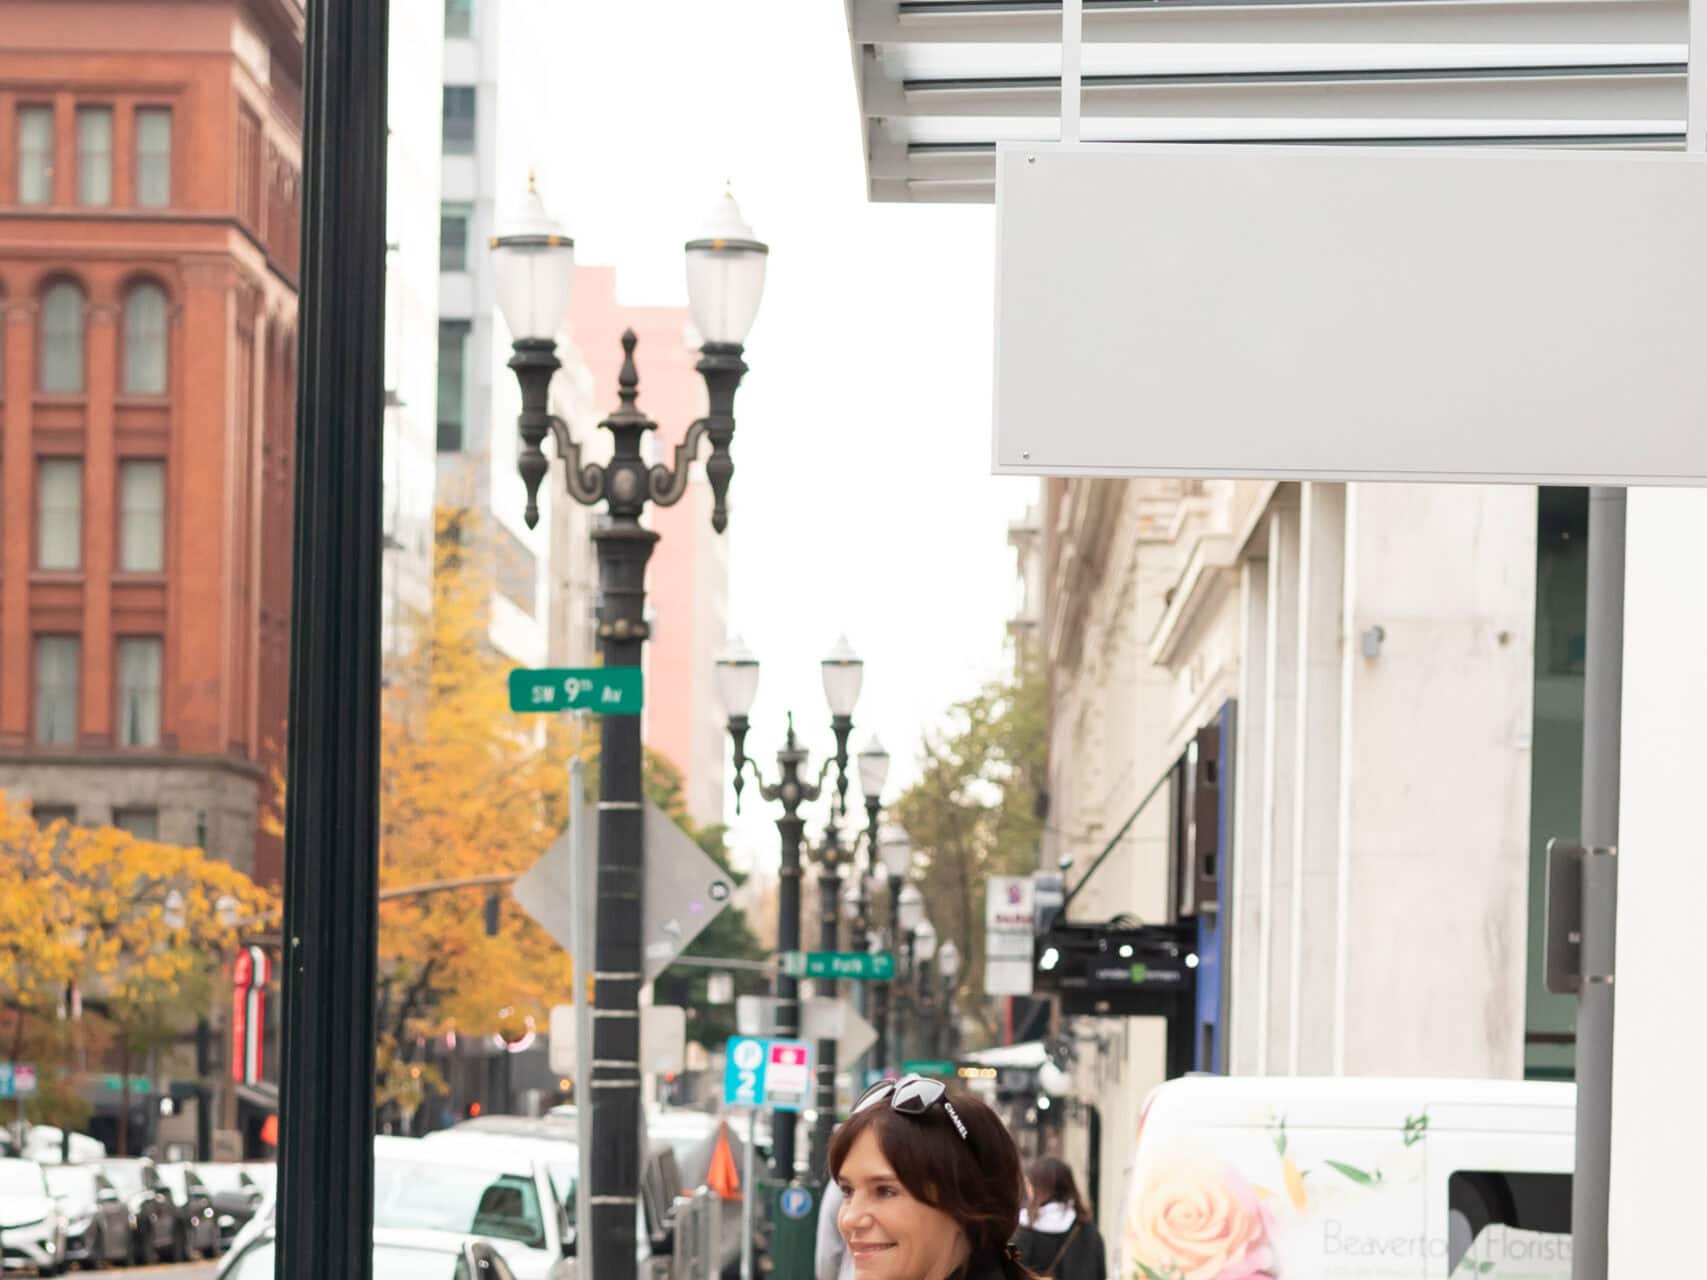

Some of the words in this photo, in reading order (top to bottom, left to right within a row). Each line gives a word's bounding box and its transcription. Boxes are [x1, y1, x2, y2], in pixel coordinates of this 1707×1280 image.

[532, 686, 555, 703] SW
[737, 1071, 756, 1097] 2
[944, 1102, 968, 1140] CHANEL
[1322, 1218, 1450, 1258] Beaverto
